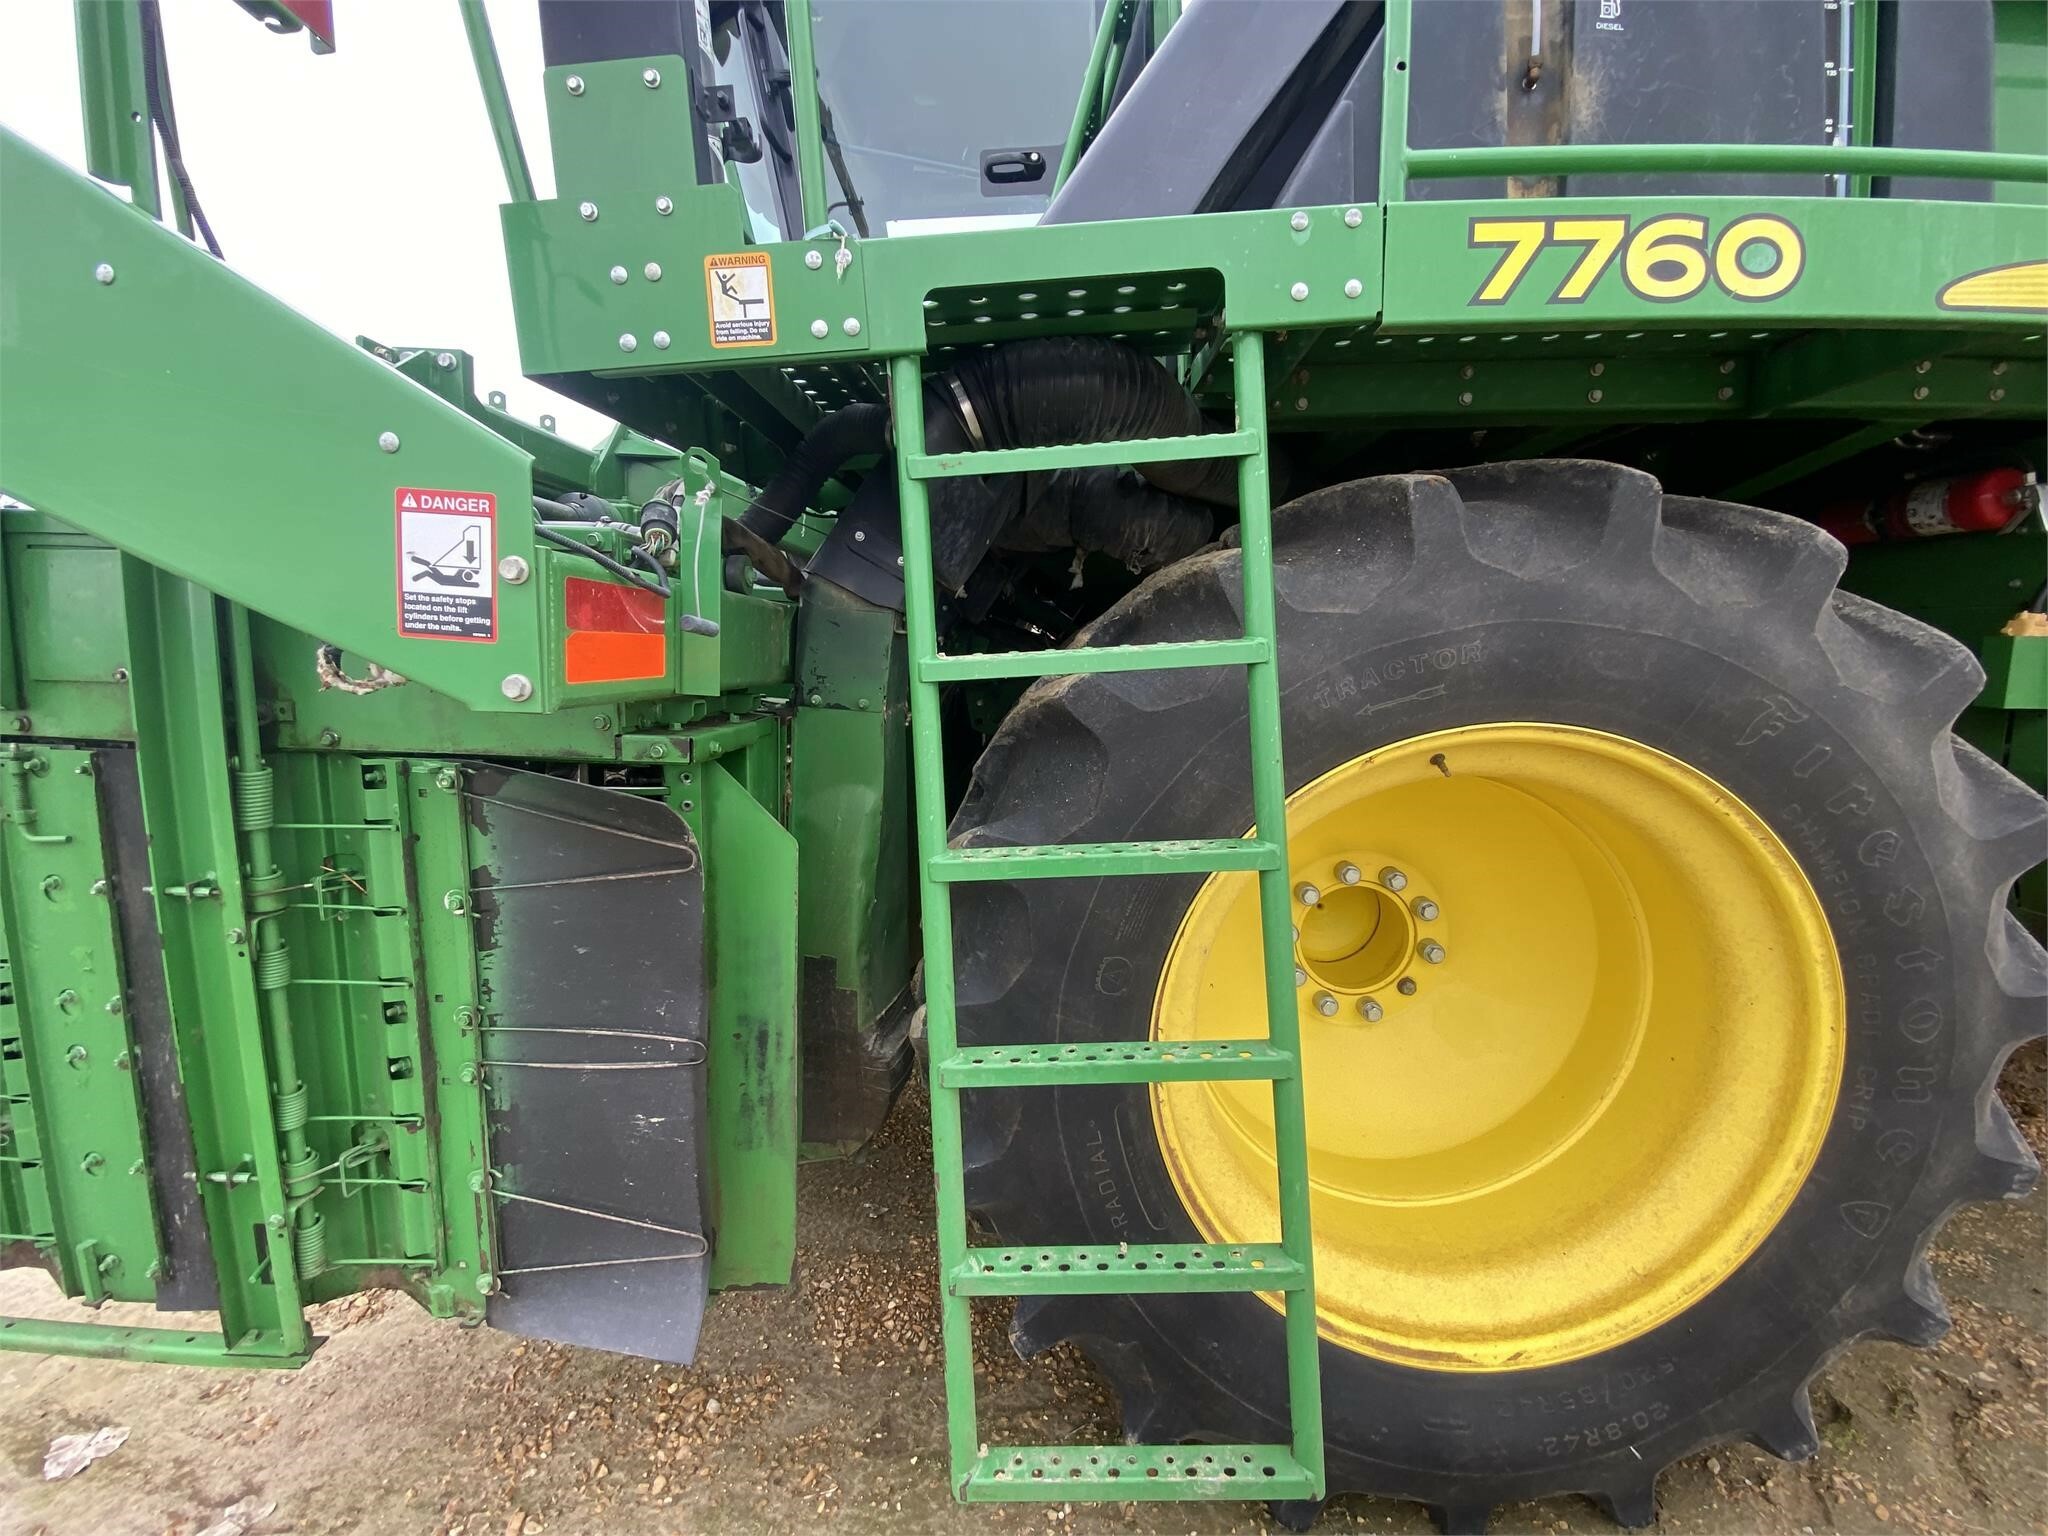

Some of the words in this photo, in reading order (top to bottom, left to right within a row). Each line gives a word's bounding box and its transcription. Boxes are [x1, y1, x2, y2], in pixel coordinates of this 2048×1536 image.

[1596, 22, 1624, 31] DIESEL
[718, 255, 766, 266] WARNING
[1467, 212, 1806, 306] 7760
[754, 320, 770, 328] injury
[421, 495, 490, 513] DANGER
[404, 593, 417, 601] Set
[418, 594, 430, 602] the
[431, 595, 454, 605] safety
[455, 597, 477, 606] stops
[404, 602, 431, 611] located
[444, 605, 456, 613] the
[457, 606, 468, 614] lift
[404, 612, 439, 622] cylinders
[440, 614, 463, 623] before
[465, 617, 491, 626] getting
[404, 621, 426, 630] under
[428, 622, 440, 630] the
[441, 623, 462, 632] units.
[1314, 640, 1482, 709] TRACTOR
[1087, 1130, 1128, 1229] RADIAL
[1543, 1402, 1670, 1457] 20.8R42
